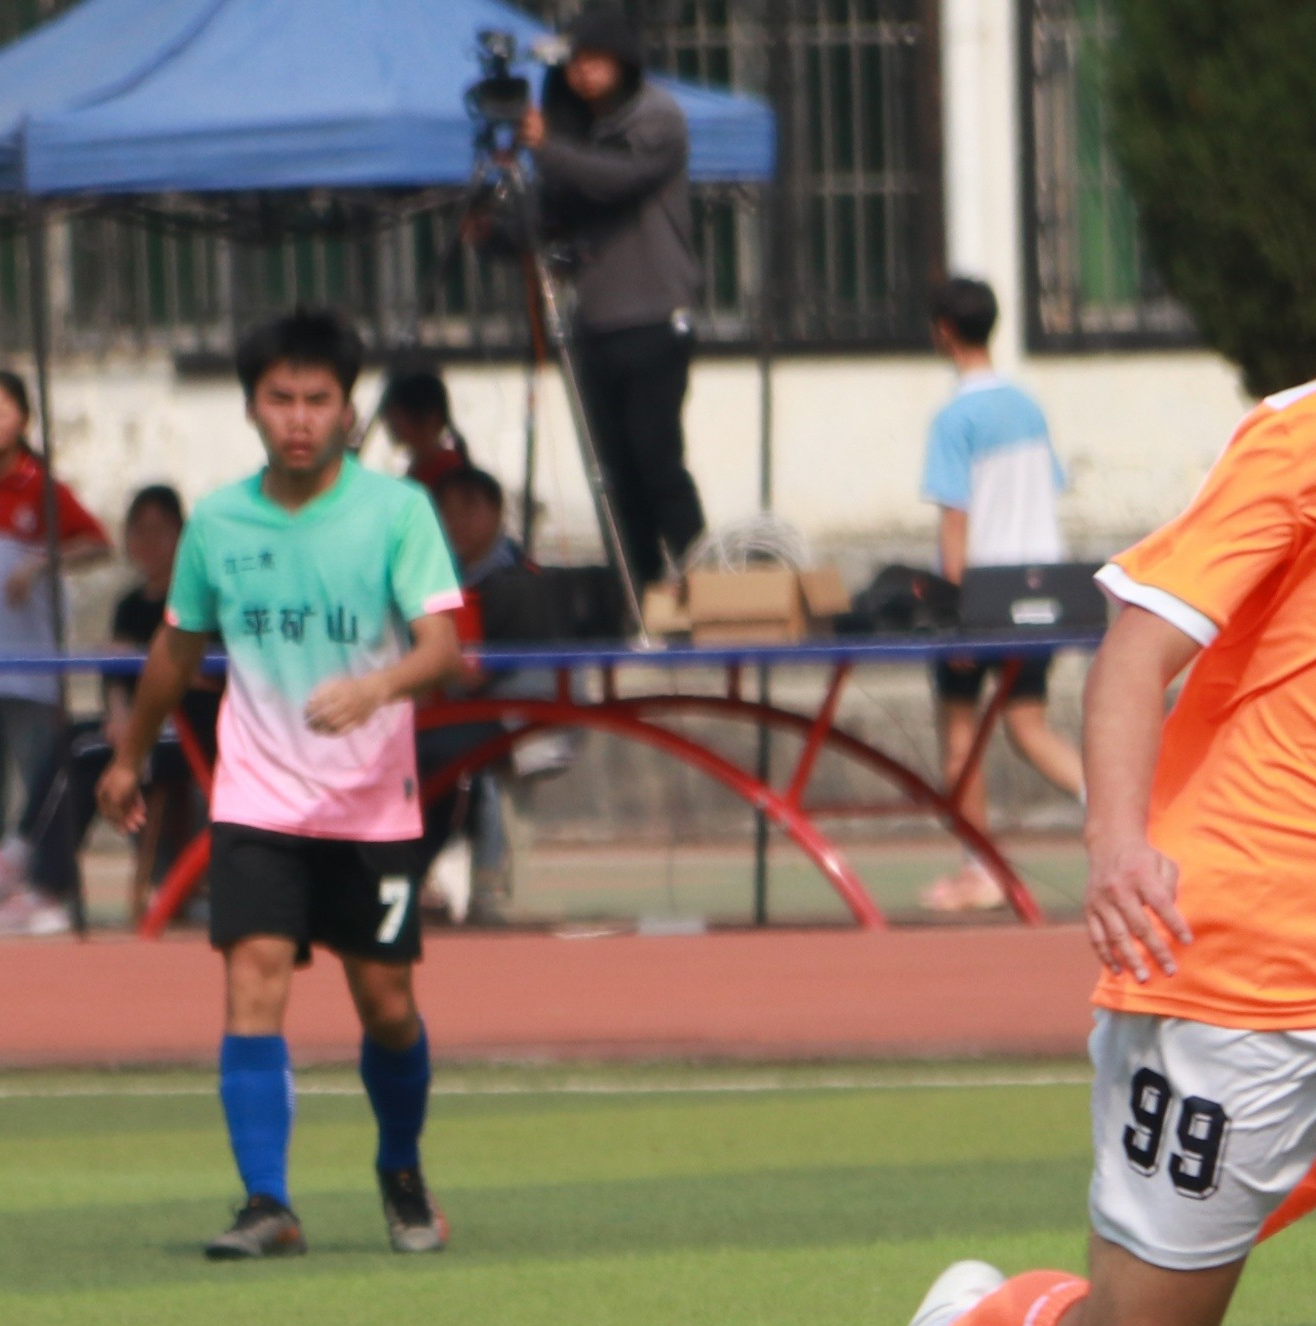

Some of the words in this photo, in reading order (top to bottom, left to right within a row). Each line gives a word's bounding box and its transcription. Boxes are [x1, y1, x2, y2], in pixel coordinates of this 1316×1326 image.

[242, 602, 359, 649] 平矿山
[377, 875, 411, 943] 7
[1122, 1066, 1231, 1200] 99
